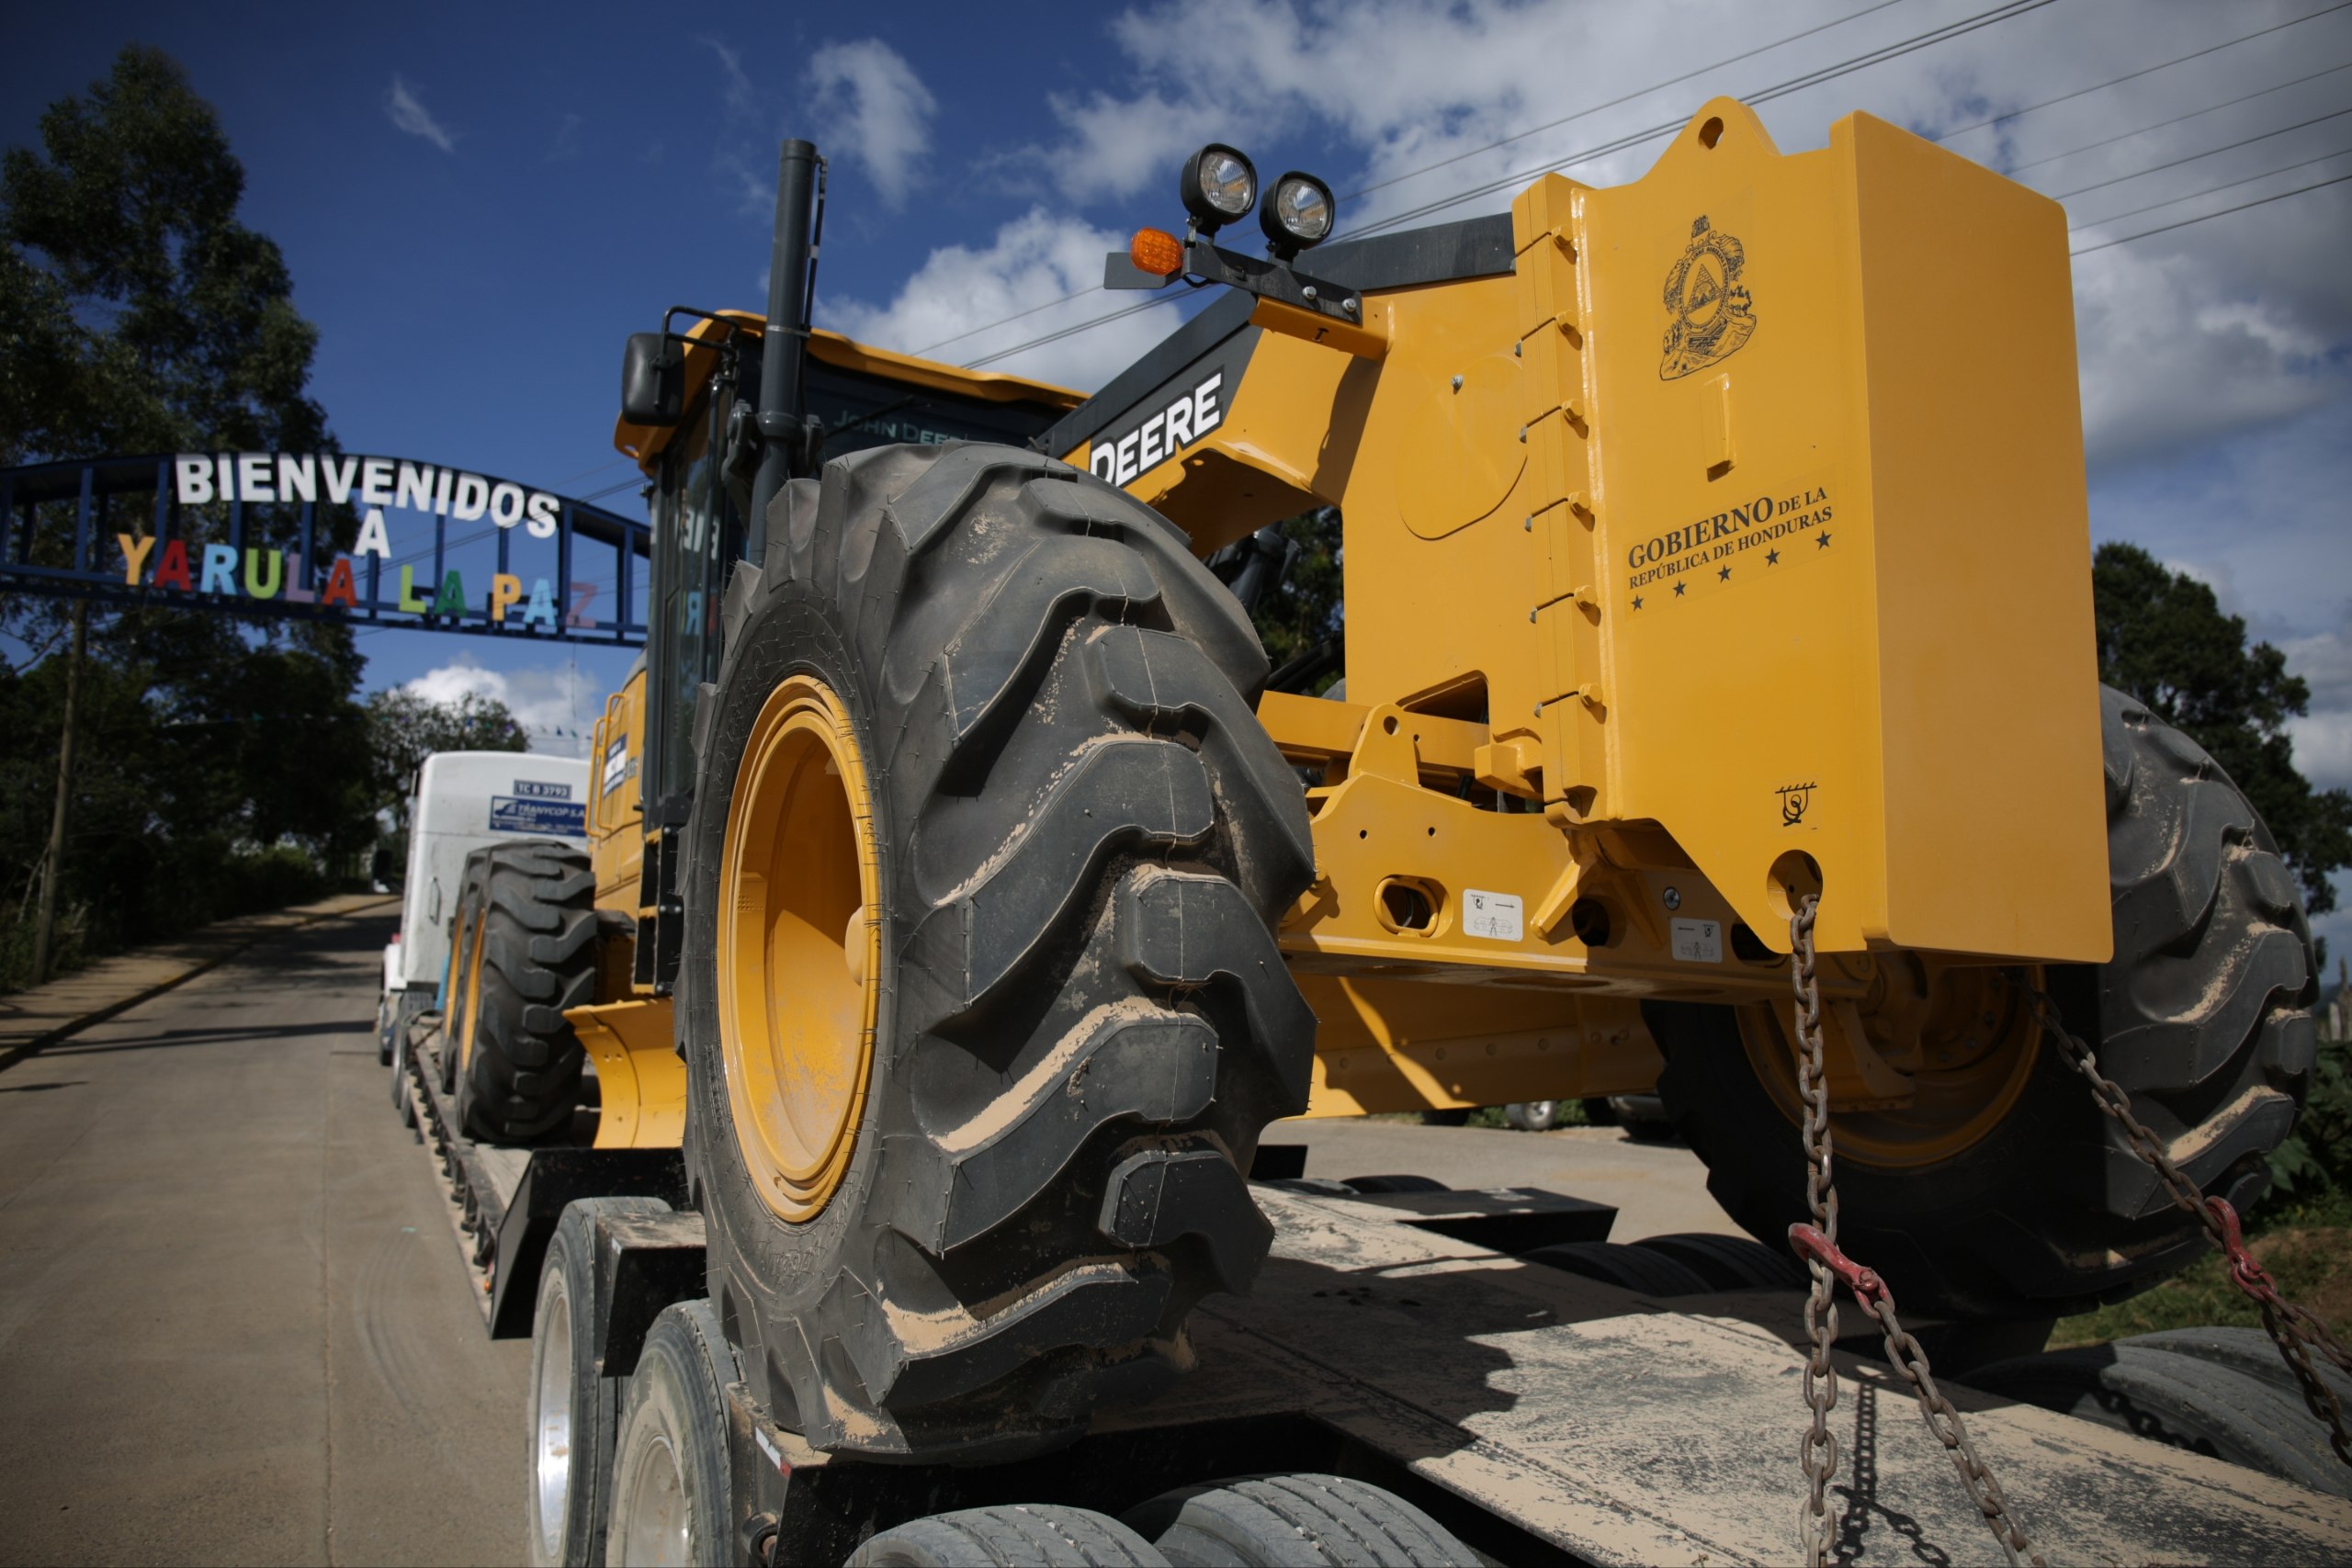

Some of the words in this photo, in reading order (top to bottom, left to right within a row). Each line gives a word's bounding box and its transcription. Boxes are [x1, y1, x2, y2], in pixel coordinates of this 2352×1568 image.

[1090, 372, 1223, 487] DEERE
[175, 453, 560, 538] BIENVENIDOS
[353, 509, 391, 558] A
[1628, 496, 1774, 570] GOBIERNO
[1778, 495, 1801, 515] DE
[1804, 486, 1827, 506] LA
[118, 533, 358, 607] YARULA
[399, 564, 468, 618] LA
[491, 573, 597, 628] PAZ
[1629, 547, 1710, 590] REPÚBLICA
[1713, 541, 1735, 561] DE
[1738, 506, 1833, 552] HONDURAS
